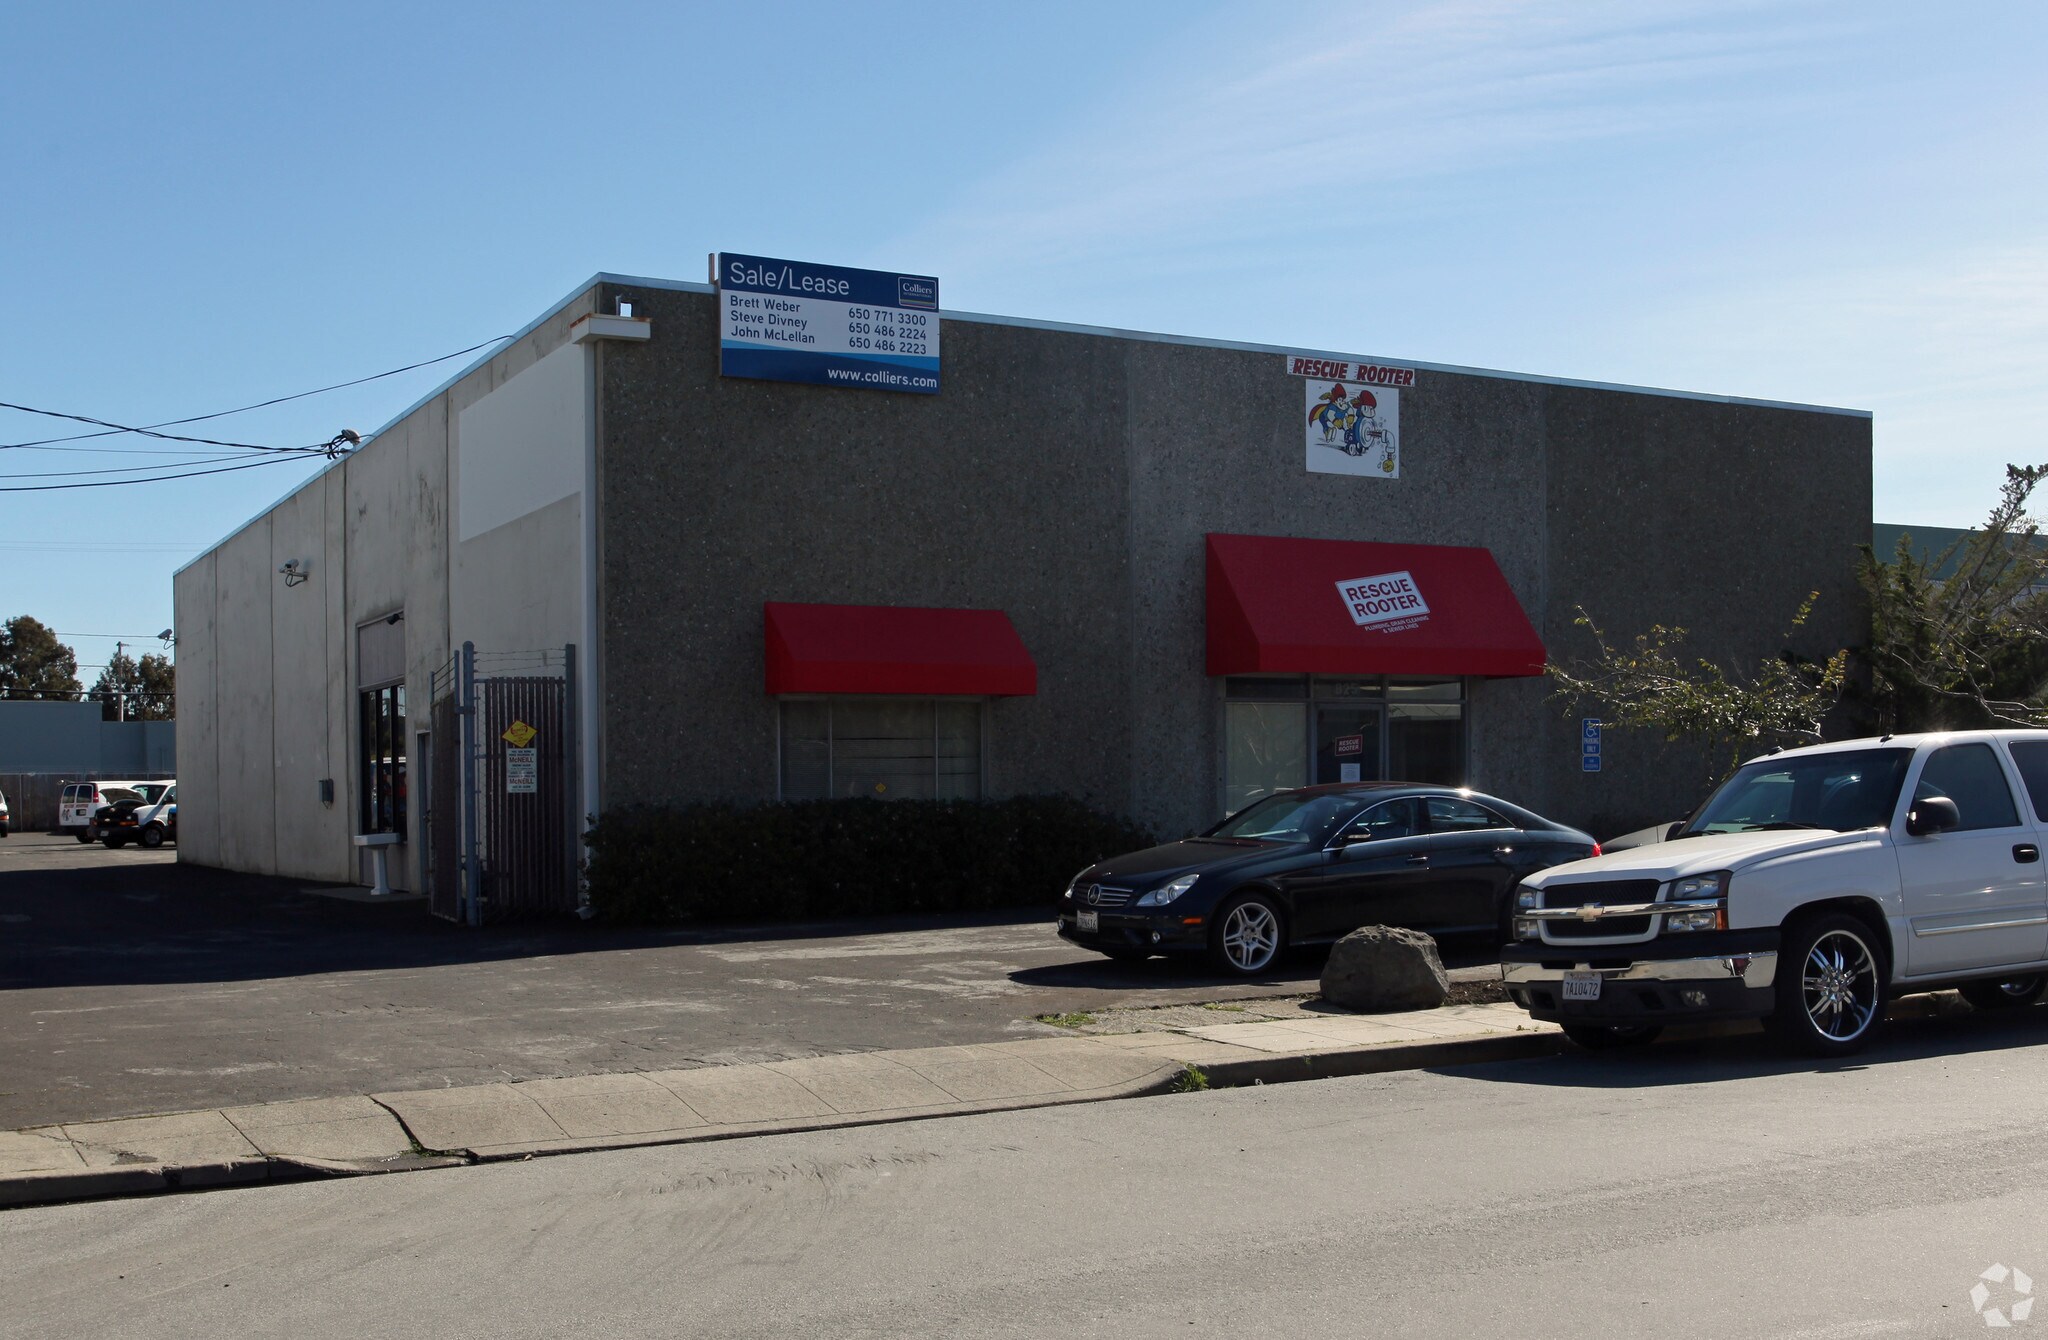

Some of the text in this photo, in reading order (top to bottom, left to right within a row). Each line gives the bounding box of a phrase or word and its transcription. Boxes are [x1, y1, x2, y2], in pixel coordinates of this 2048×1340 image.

[730, 262, 850, 296] Sale/Lease
[902, 282, 933, 295] Colliers
[730, 296, 801, 313] Brett Weber
[730, 310, 807, 331] Steve Divney
[849, 308, 926, 326] 650 771 3300
[731, 325, 815, 344] John McLellan
[849, 322, 926, 341] 650 486 2224
[849, 337, 927, 355] 650 486 2223
[828, 368, 937, 388] www.colliers.com
[1293, 358, 1414, 385] RESCUE ROOTER
[1345, 579, 1412, 602] RESCUE
[1353, 594, 1422, 617] ROOTER
[1338, 738, 1360, 747] RESCUE
[1338, 744, 1360, 752] ROOTER
